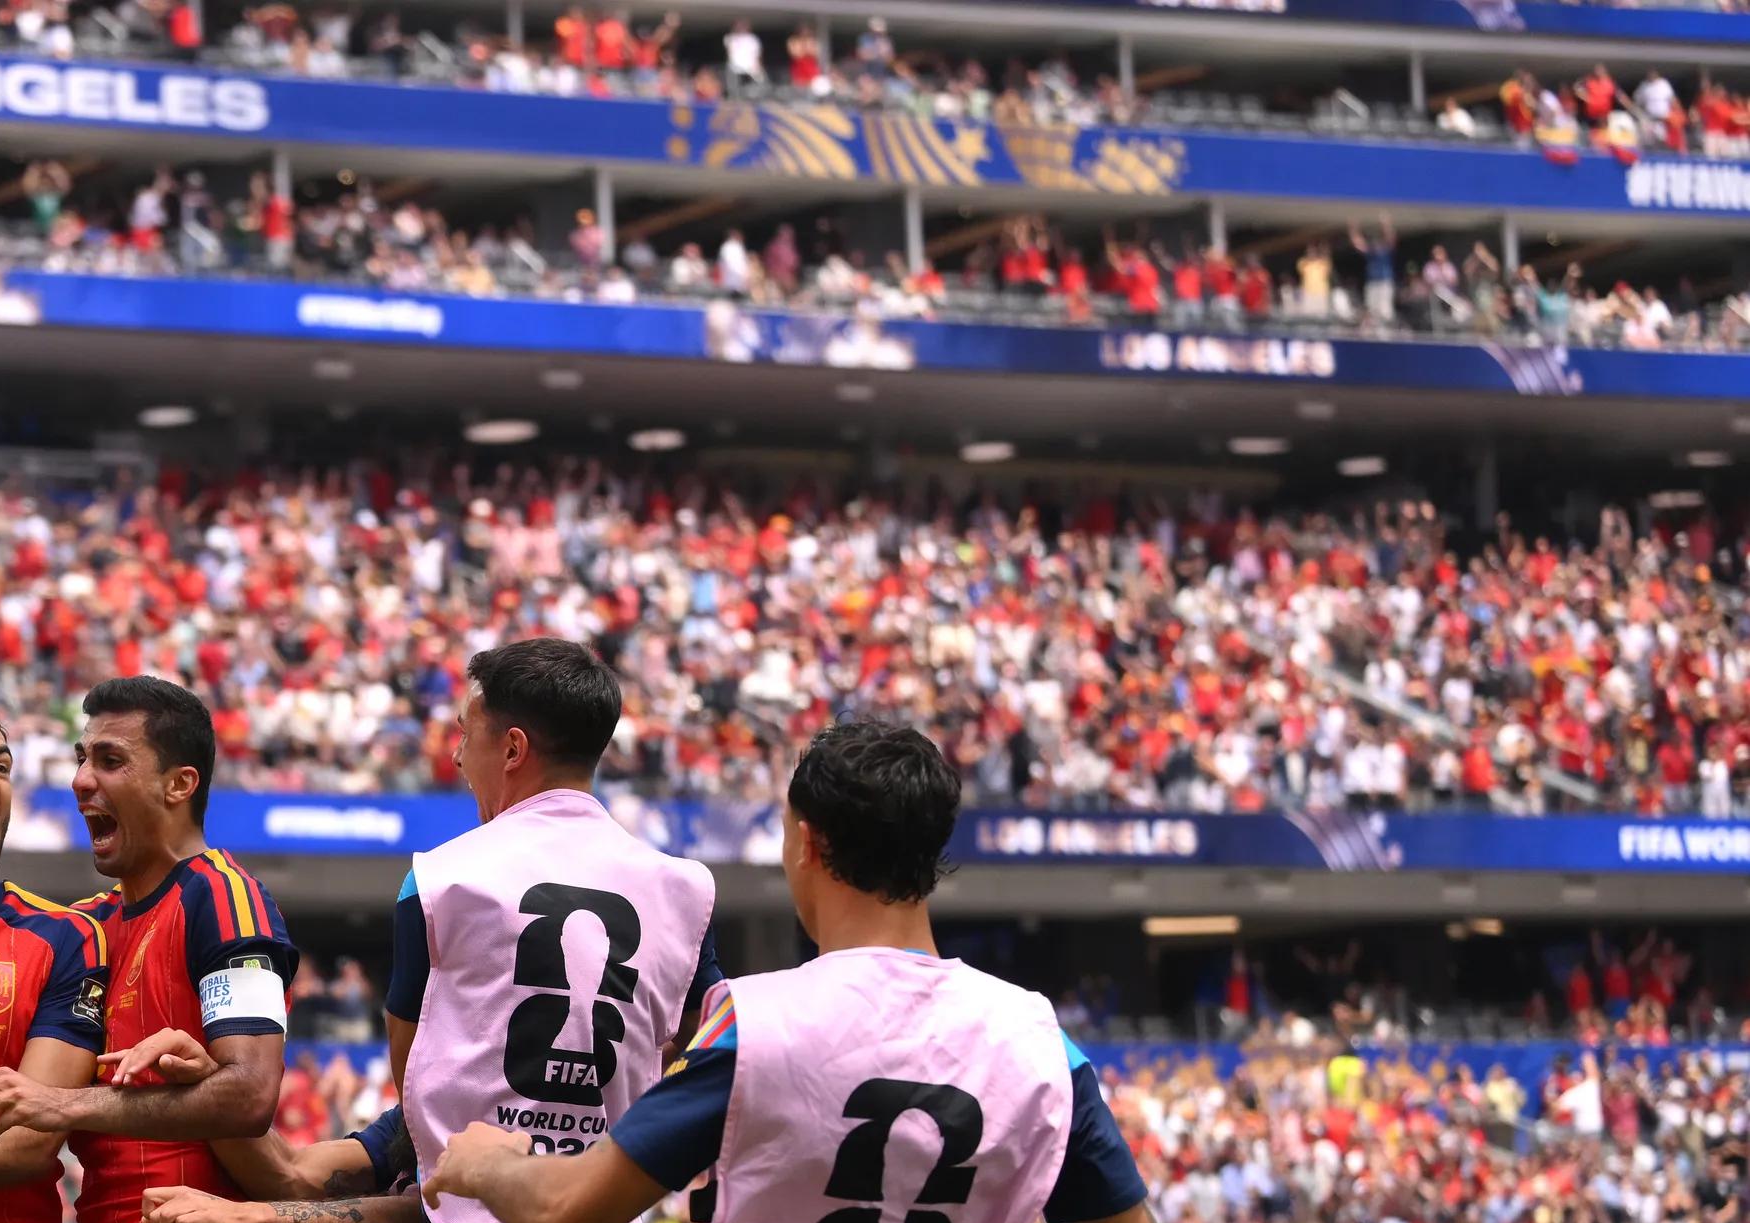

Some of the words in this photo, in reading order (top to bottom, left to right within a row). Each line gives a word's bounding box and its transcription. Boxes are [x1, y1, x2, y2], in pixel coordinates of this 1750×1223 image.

[1618, 825, 1684, 861] FIFA
[544, 1060, 598, 1087] FIFA
[497, 1105, 576, 1132] WORLD
[579, 1115, 608, 1134] CU
